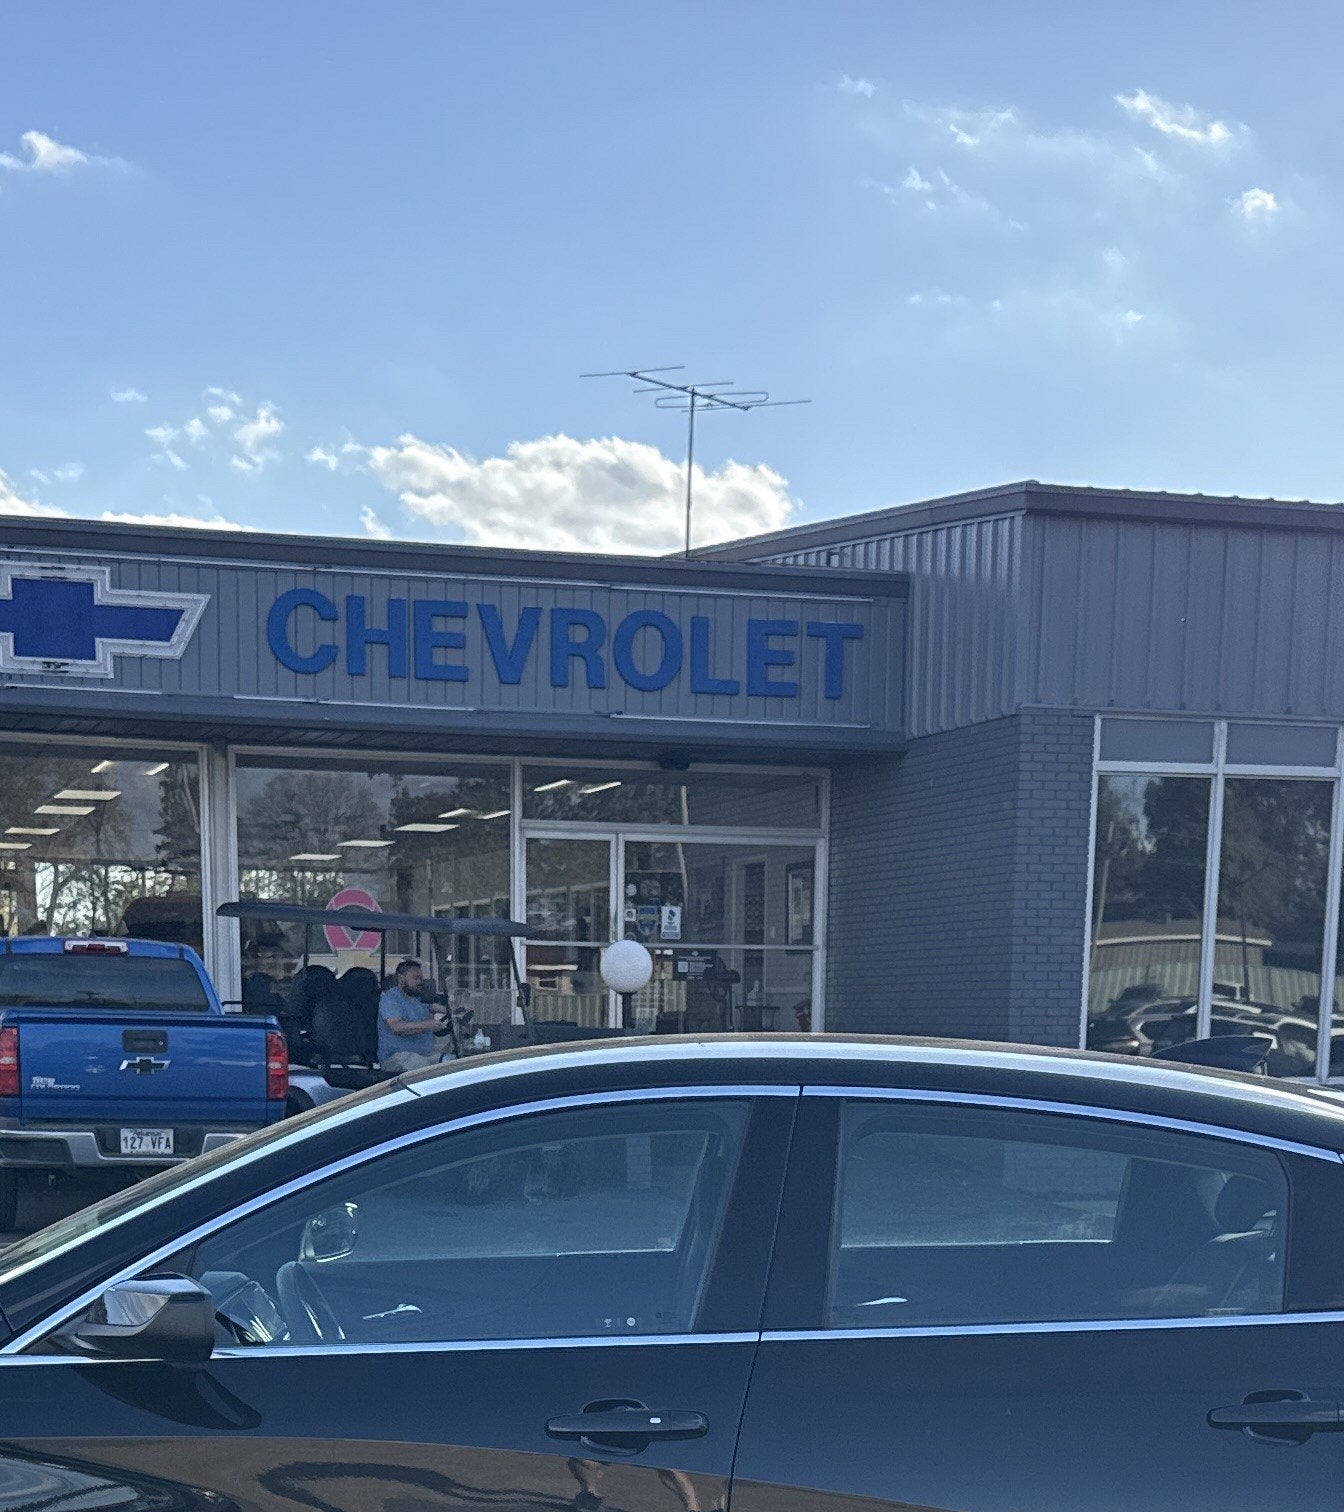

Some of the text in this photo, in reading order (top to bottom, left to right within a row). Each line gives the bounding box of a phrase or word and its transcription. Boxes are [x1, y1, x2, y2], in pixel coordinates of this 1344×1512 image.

[267, 588, 864, 700] CHEVROLET
[123, 1136, 172, 1150] 127 VFA
